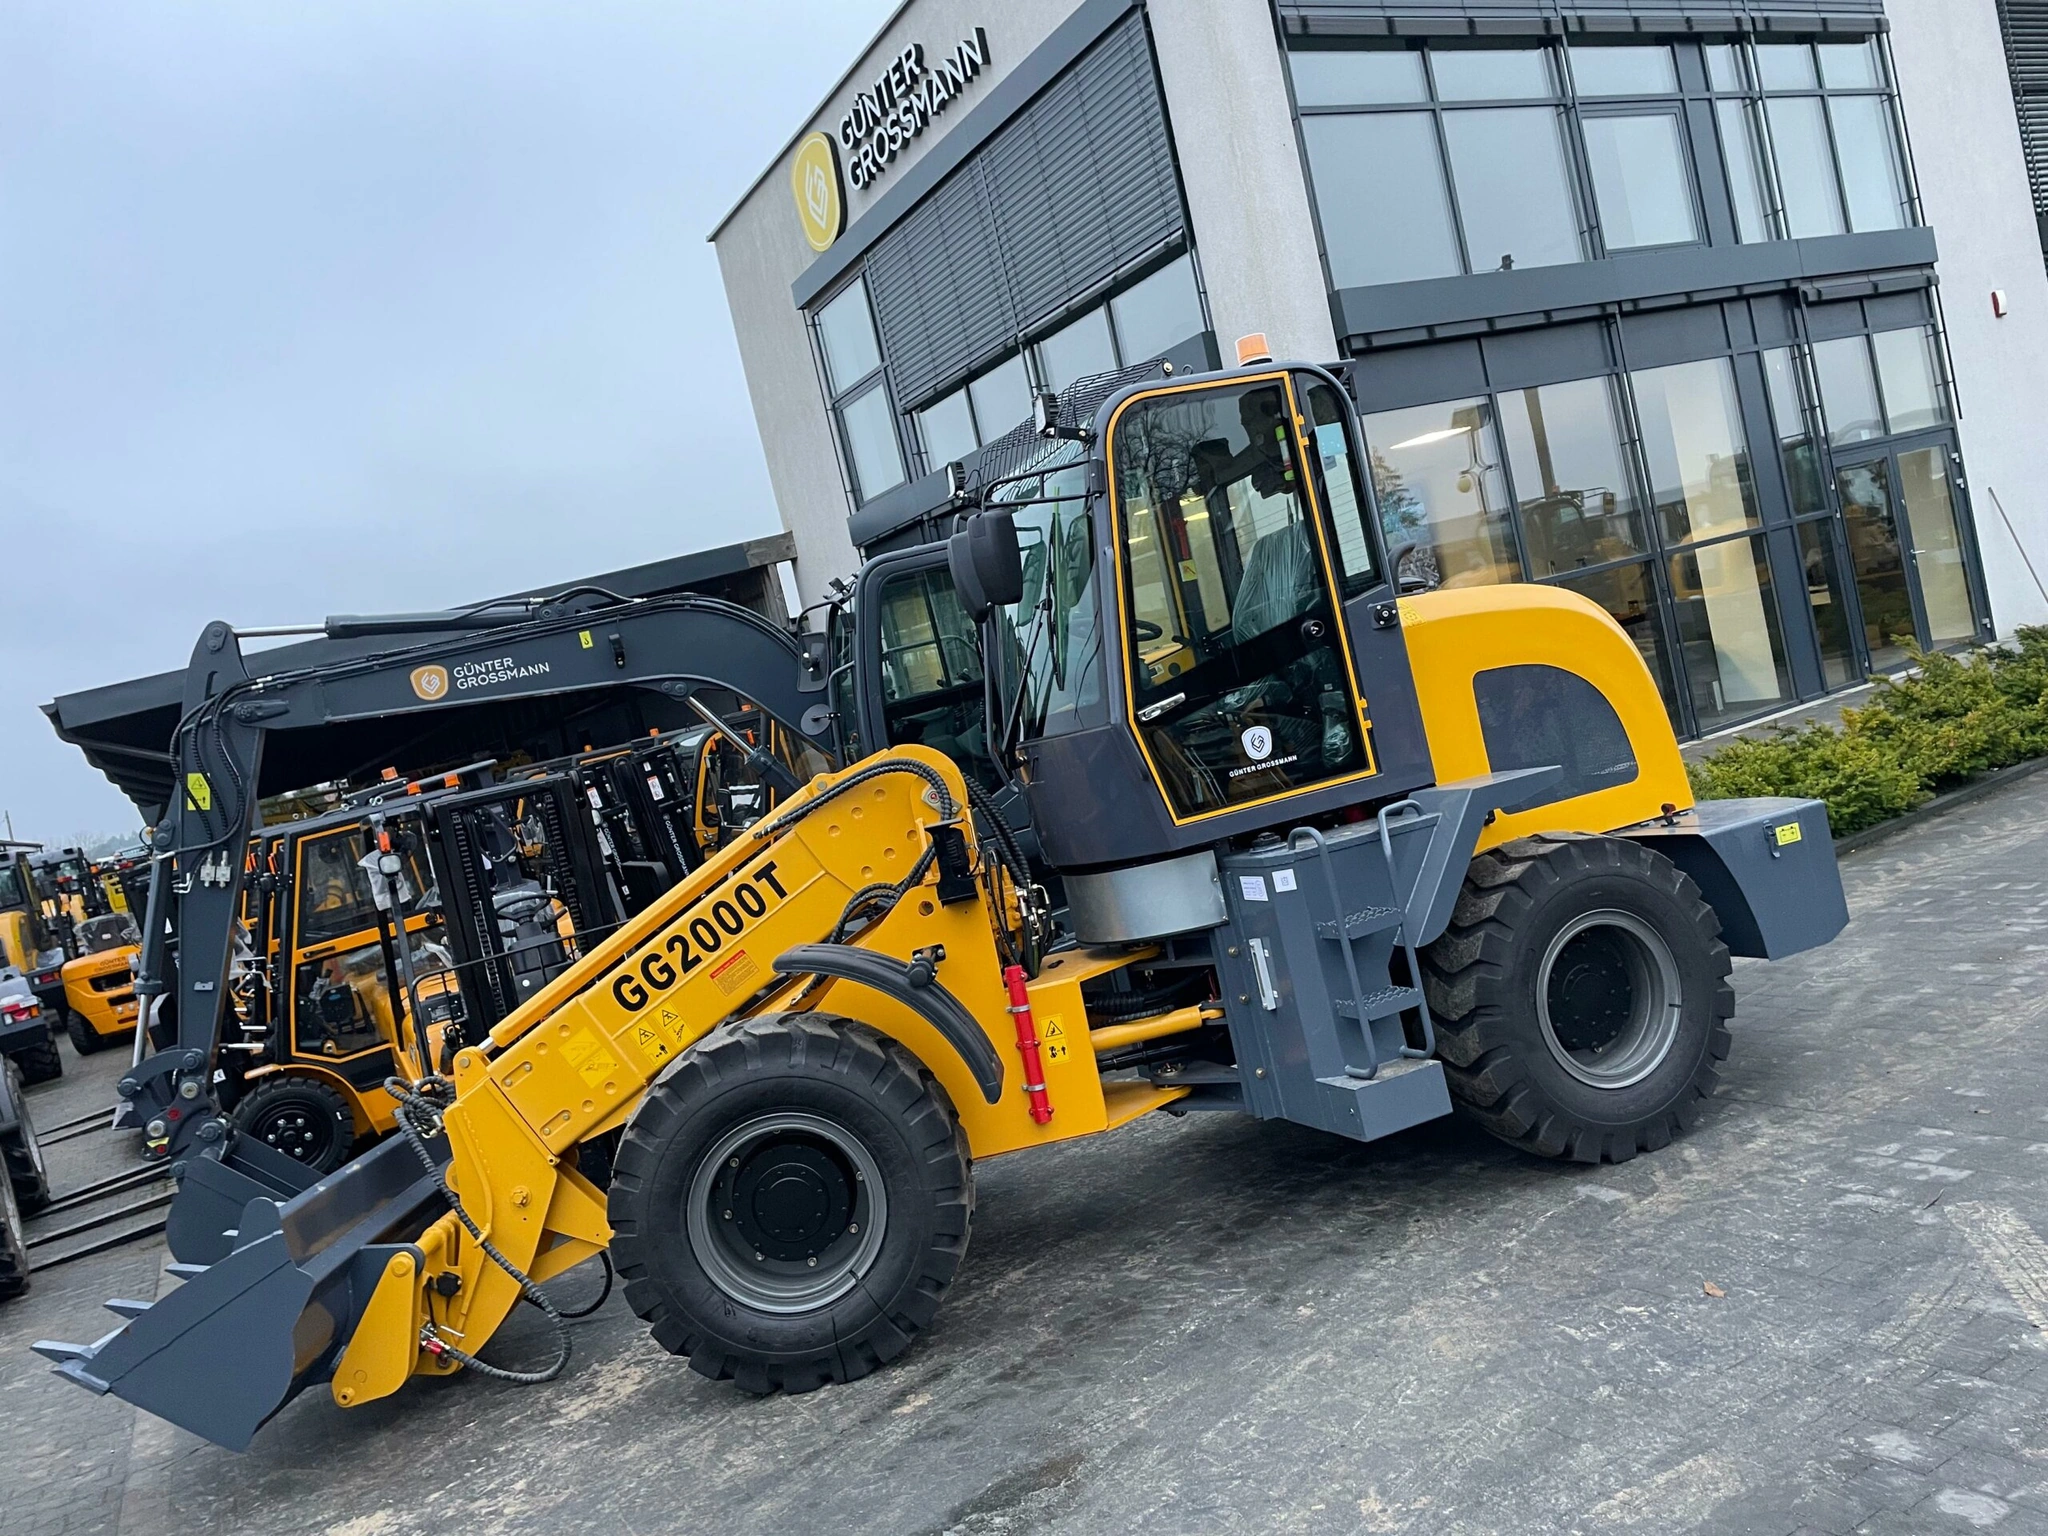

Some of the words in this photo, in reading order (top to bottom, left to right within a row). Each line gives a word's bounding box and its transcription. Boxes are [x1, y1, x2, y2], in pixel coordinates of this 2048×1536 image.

[839, 43, 927, 149] GÜNTER
[848, 27, 990, 190] GROSSMANN
[453, 657, 514, 677] GÜNTER
[457, 662, 550, 689] GROSSMANN
[1229, 766, 1256, 777] GÜNTER
[1256, 755, 1297, 770] GROSSMANN
[612, 861, 788, 1011] GG2000T
